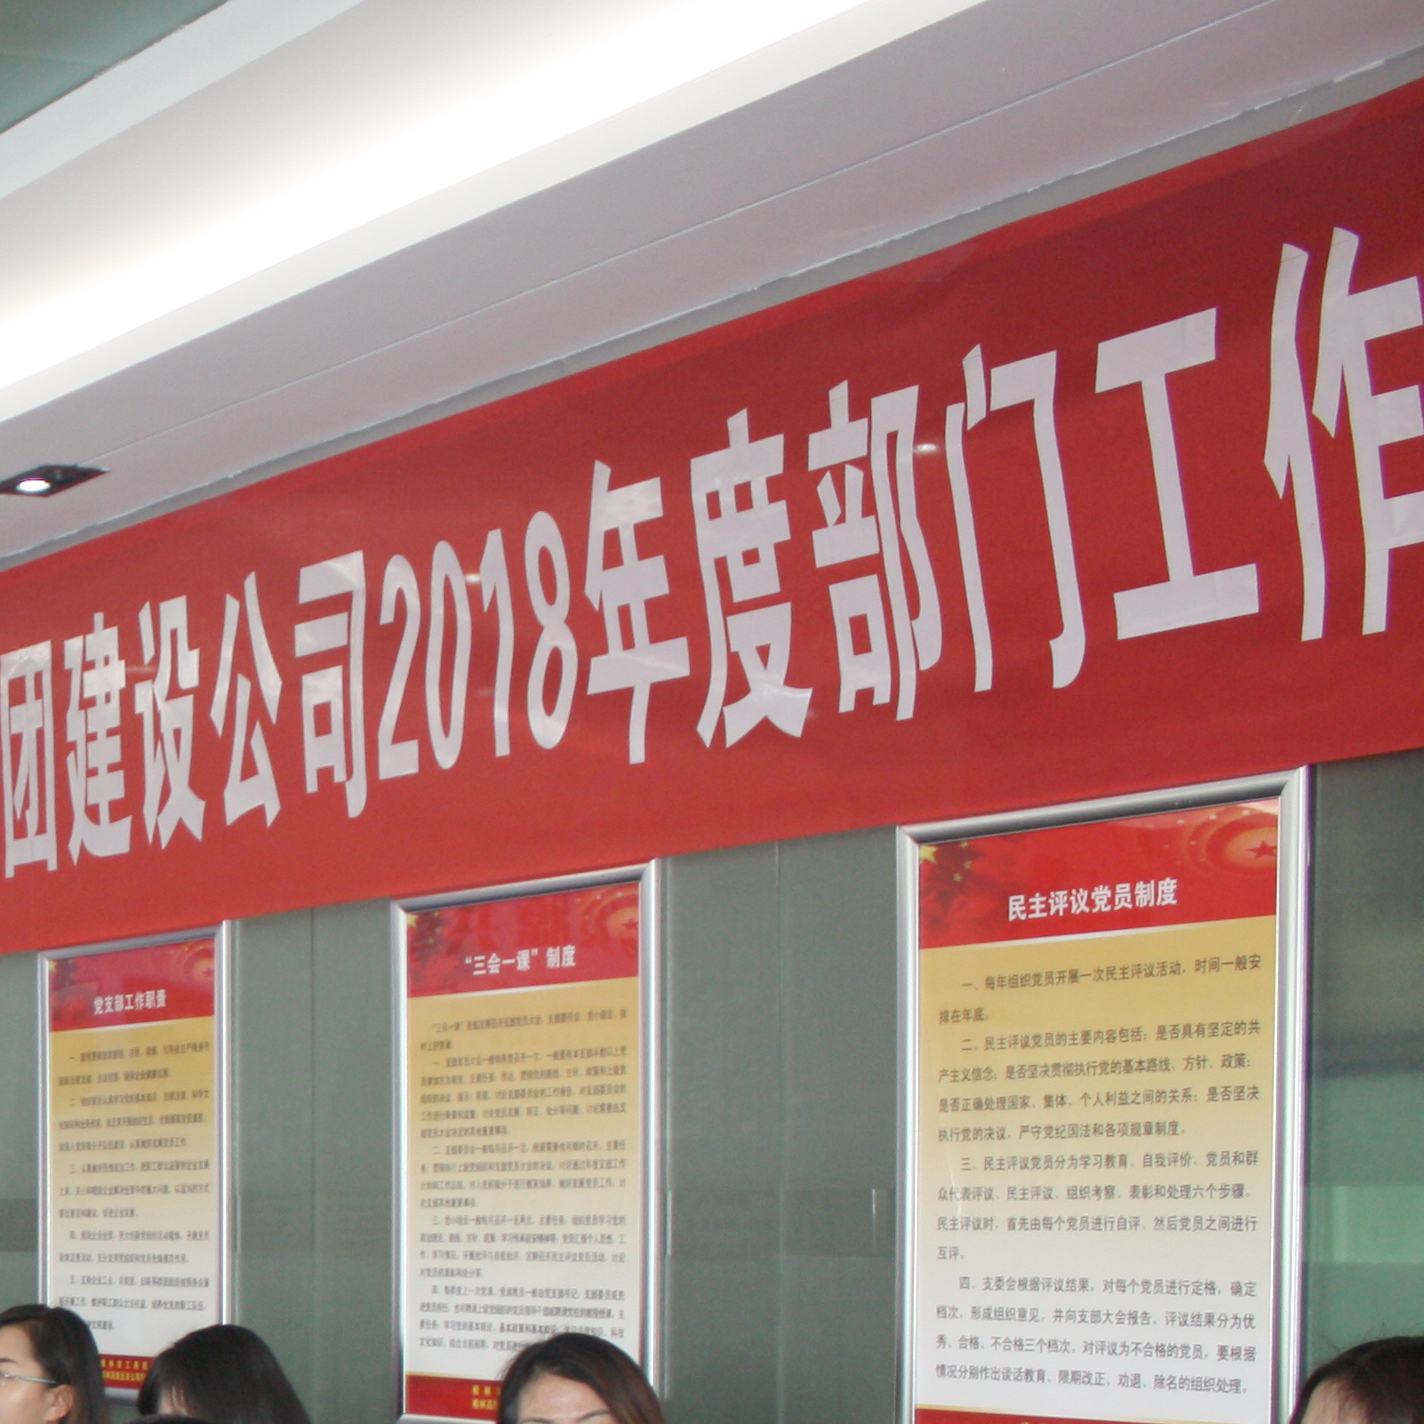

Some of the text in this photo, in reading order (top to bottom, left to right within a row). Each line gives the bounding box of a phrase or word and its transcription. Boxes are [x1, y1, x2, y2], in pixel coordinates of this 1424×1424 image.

[1007, 877, 1178, 922] 民主评议党员制度
[93, 989, 166, 1015] 党支部工作职责
